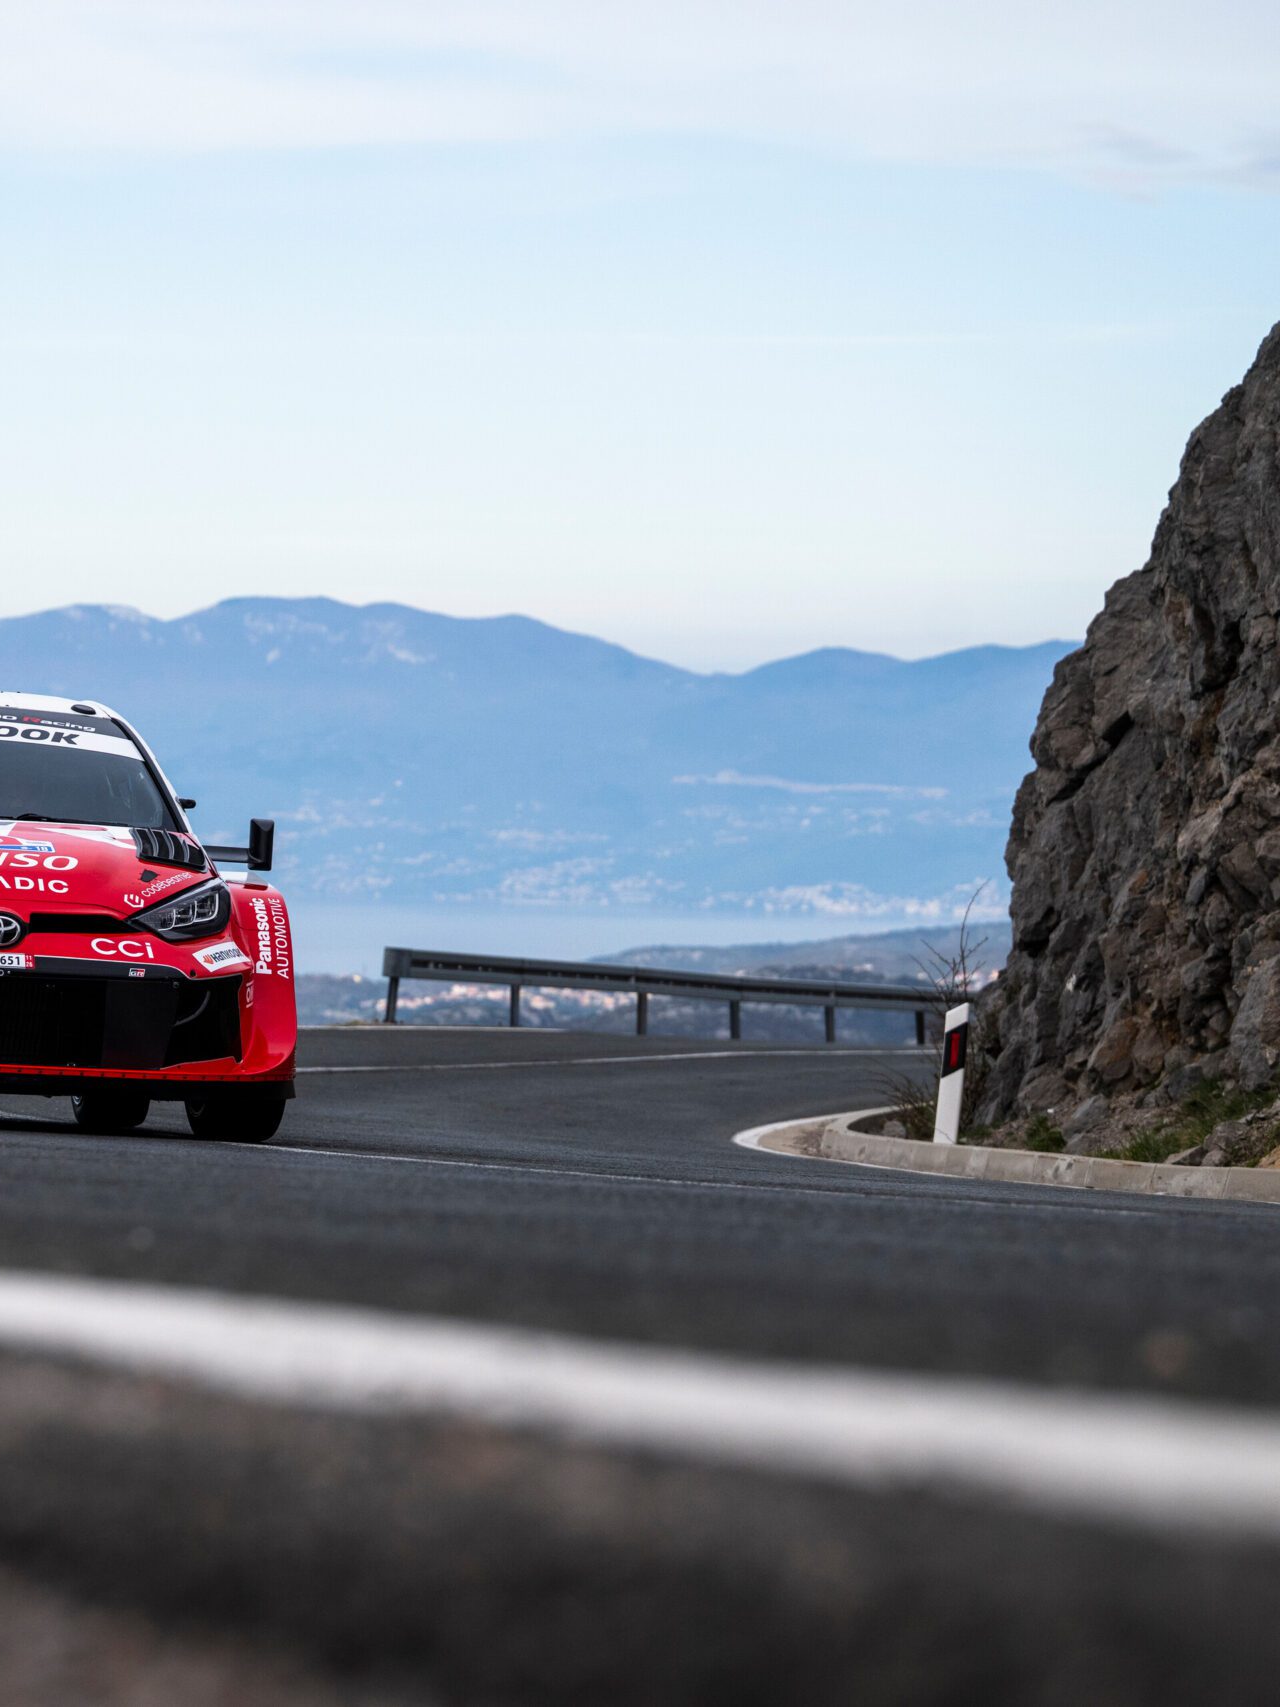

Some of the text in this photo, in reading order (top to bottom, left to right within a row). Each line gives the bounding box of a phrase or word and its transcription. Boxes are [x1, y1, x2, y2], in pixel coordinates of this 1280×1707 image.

[23, 715, 96, 732] Racing
[249, 897, 273, 975] Panasonic
[268, 897, 290, 979] AUTOMOTIVE
